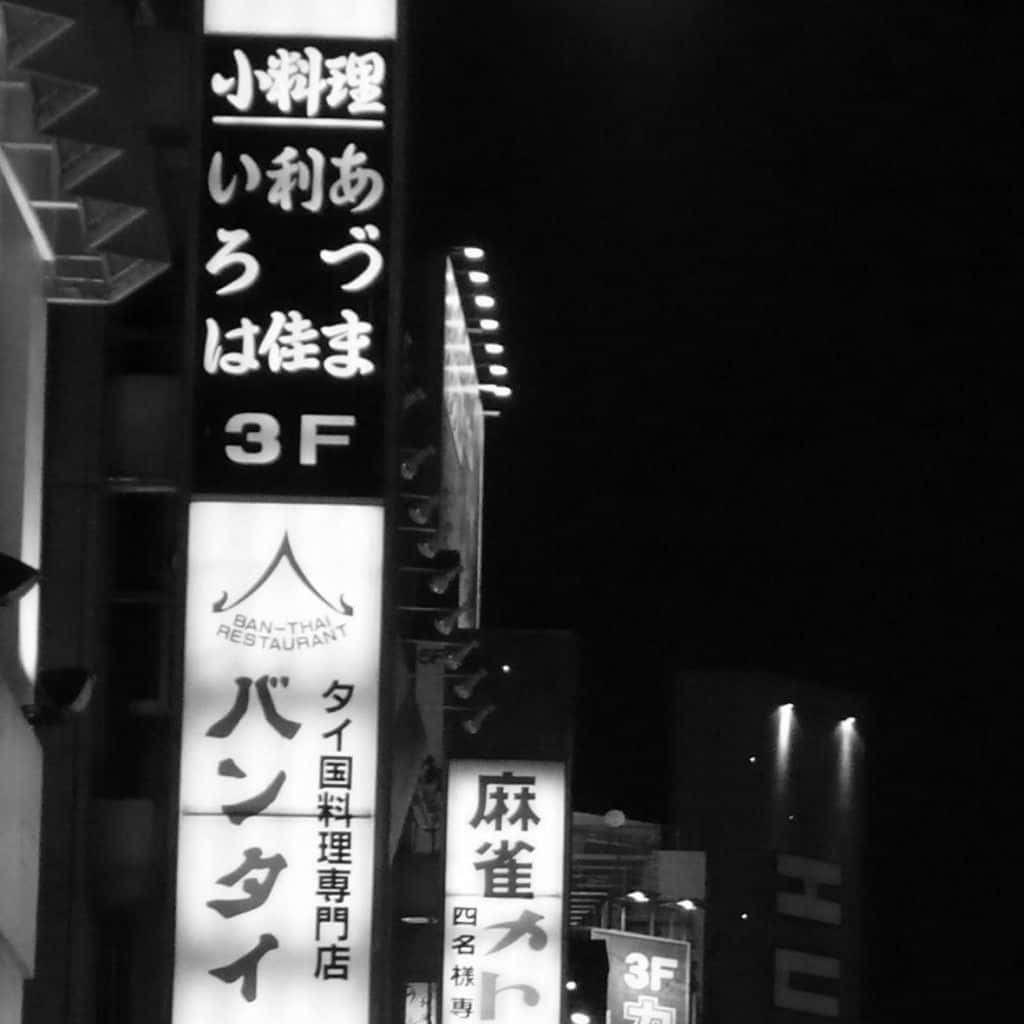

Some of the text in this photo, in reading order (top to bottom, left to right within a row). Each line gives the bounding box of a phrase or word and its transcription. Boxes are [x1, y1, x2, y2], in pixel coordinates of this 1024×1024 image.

[212, 46, 386, 117] 小料理
[203, 149, 262, 376] いろは
[320, 143, 385, 378] あづま
[224, 412, 357, 466] 3F
[215, 624, 352, 652] RESTAURANT
[233, 613, 332, 632] BAN-THAI
[204, 675, 302, 1002] バンタイ
[313, 680, 355, 980] タイ国料理専門店
[469, 772, 541, 900] 麻雀
[624, 953, 678, 991] 3F
